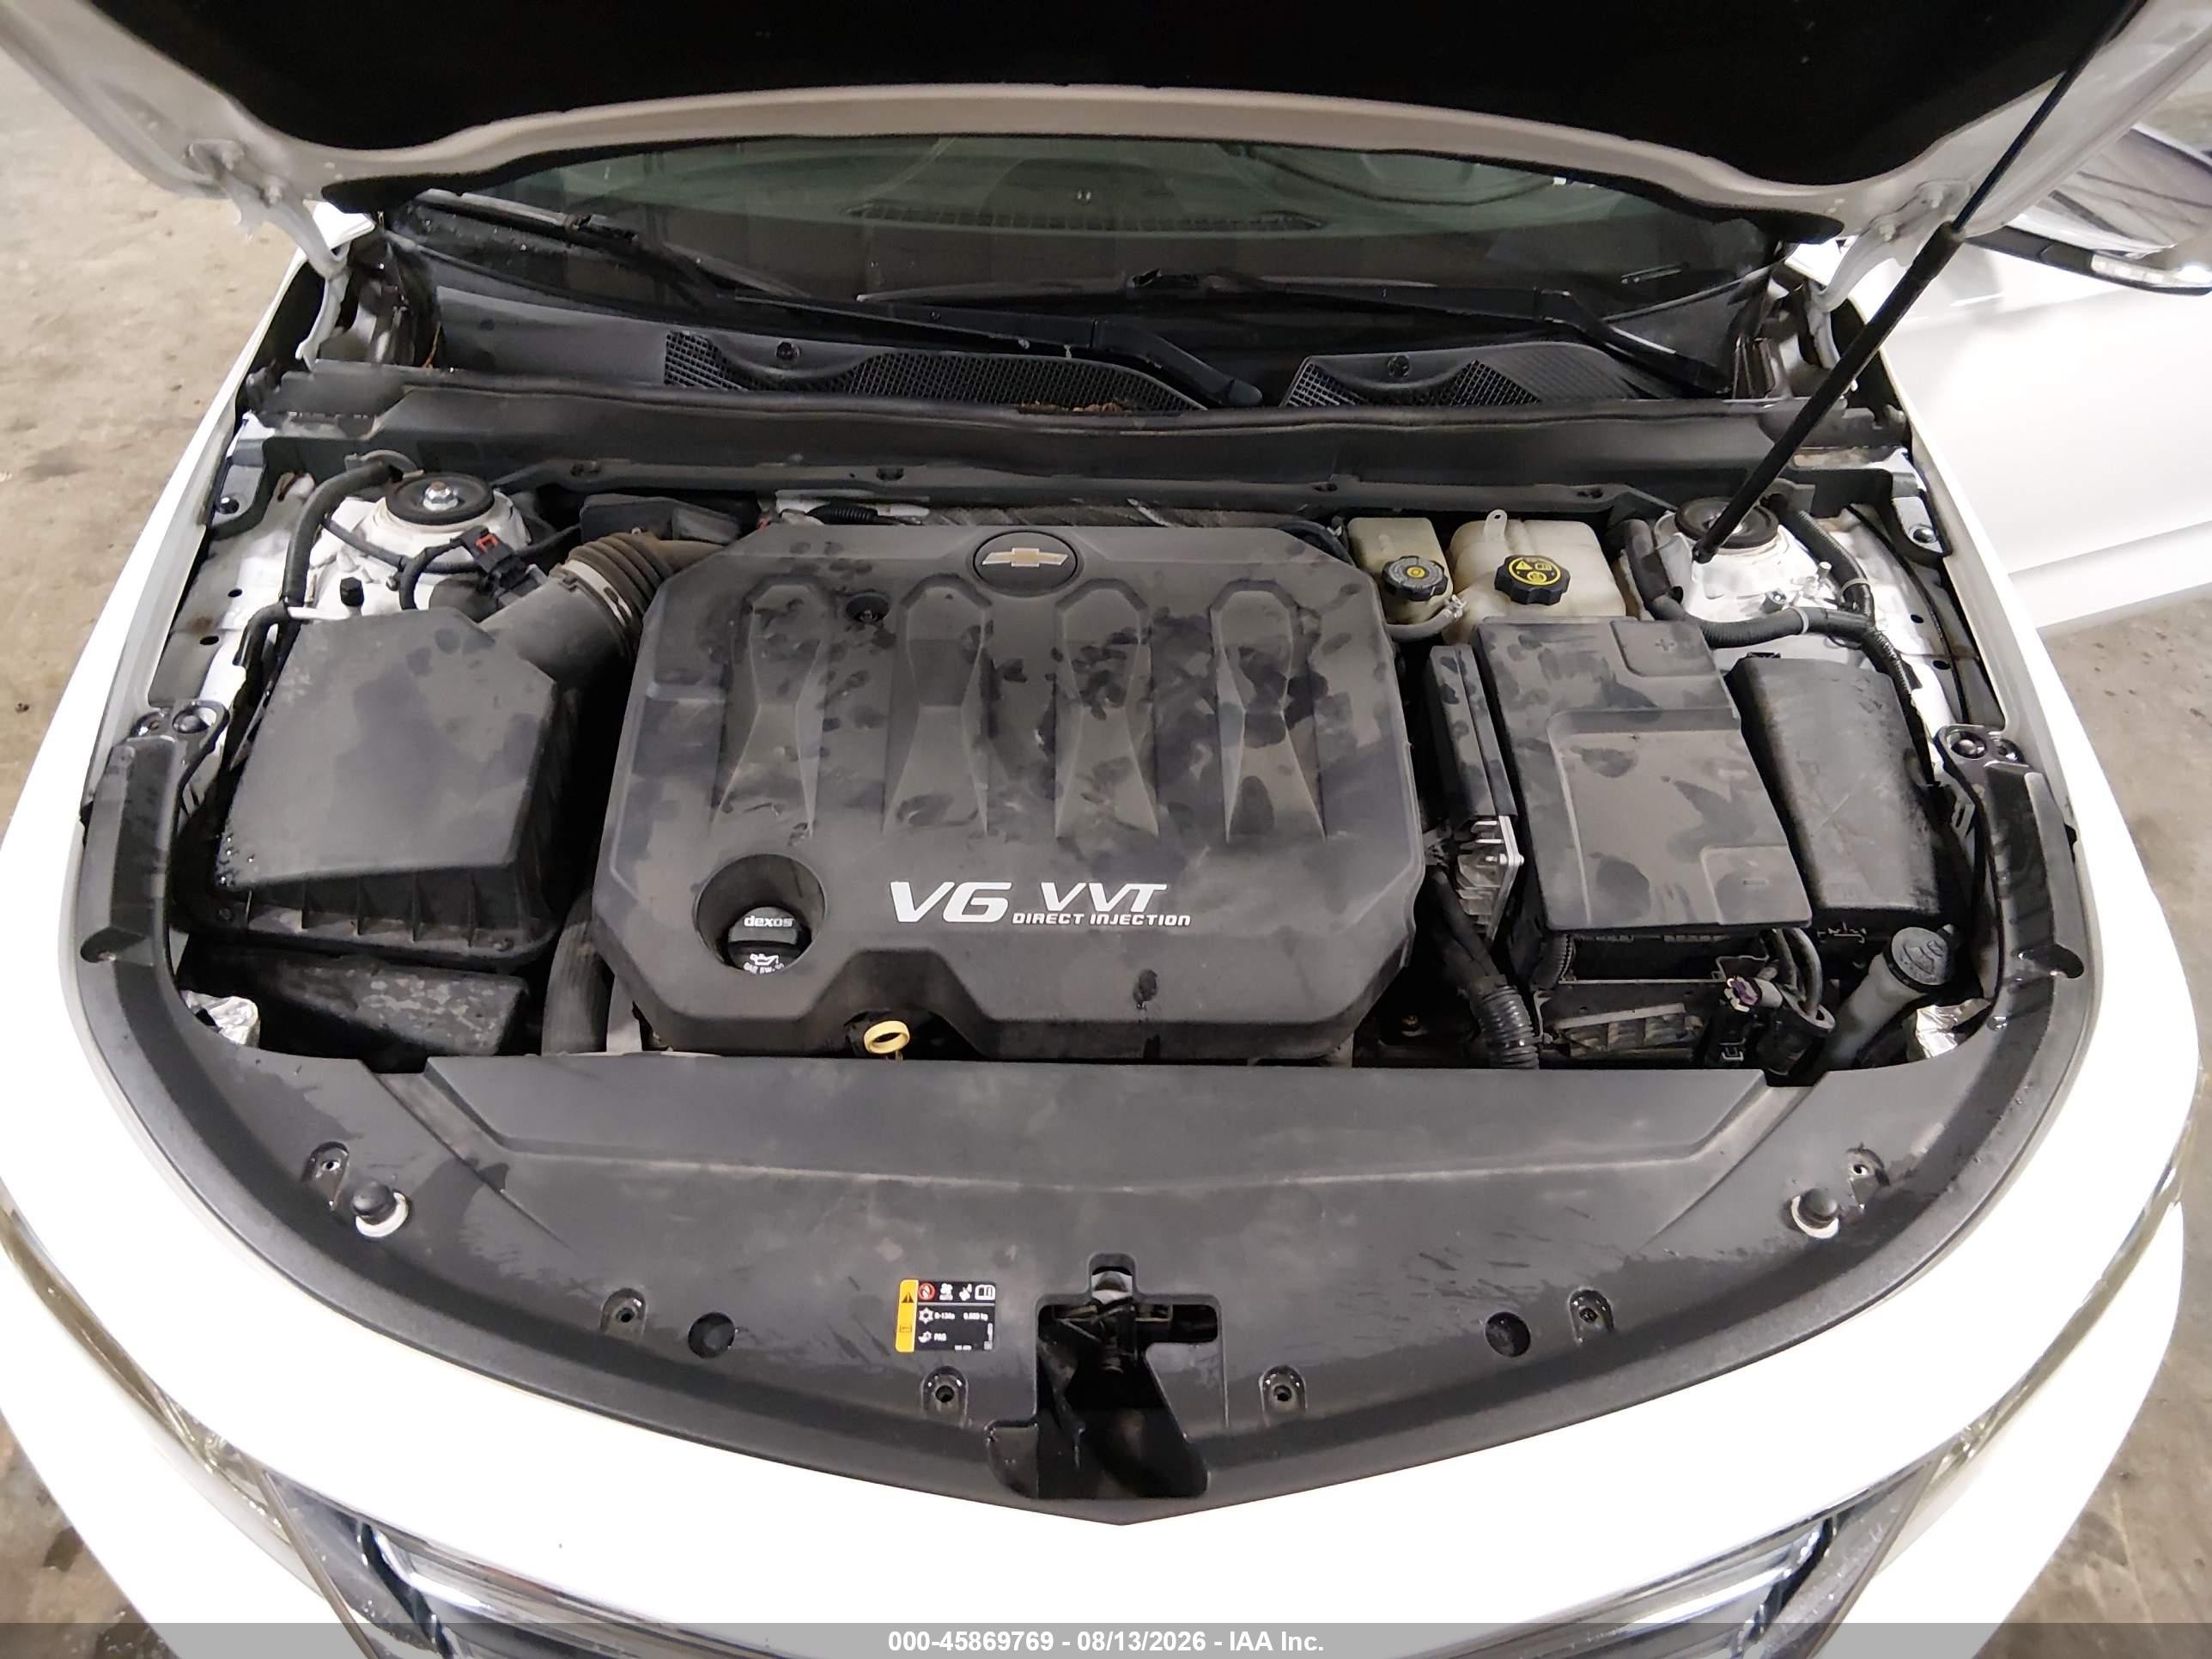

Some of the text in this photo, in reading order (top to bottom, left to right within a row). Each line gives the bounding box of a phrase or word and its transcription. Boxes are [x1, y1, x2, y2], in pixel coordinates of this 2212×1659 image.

[890, 881, 1168, 923] V6 VVT
[744, 915, 795, 927] dexos
[1012, 913, 1191, 927] DIRECT INJECTION
